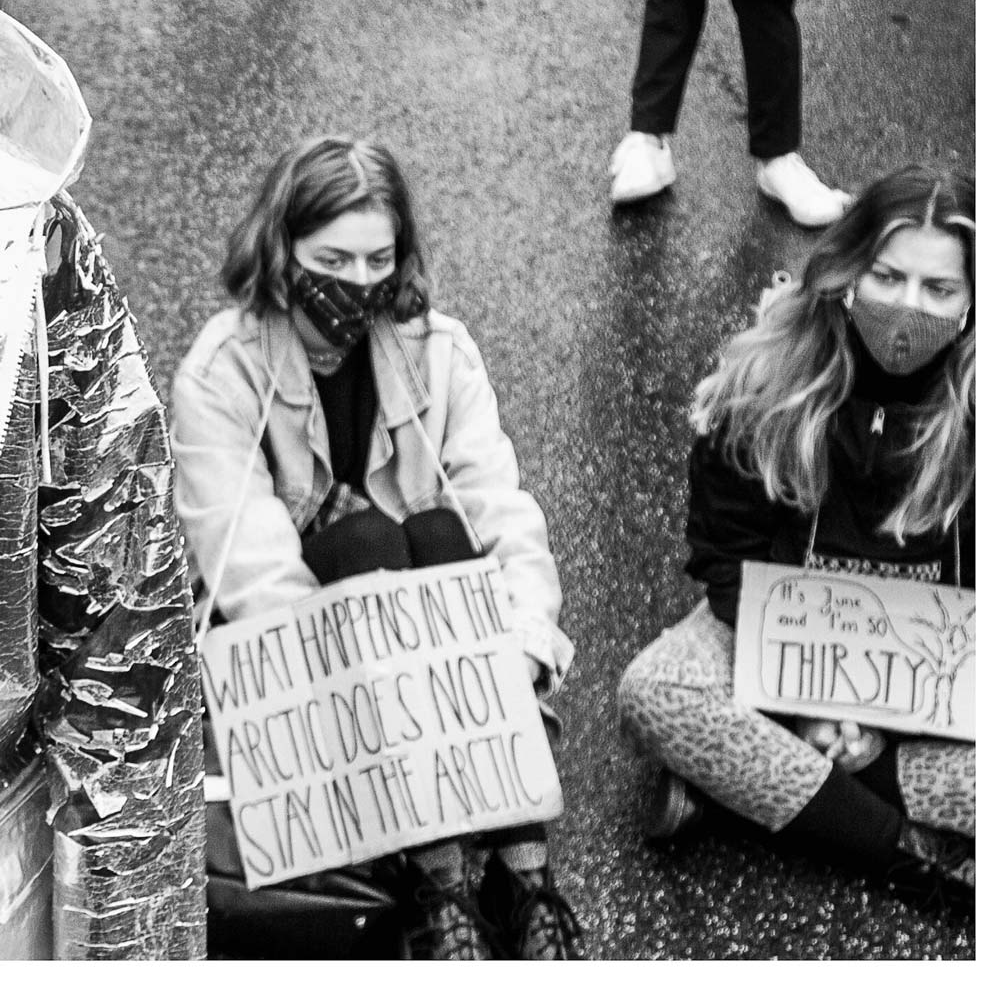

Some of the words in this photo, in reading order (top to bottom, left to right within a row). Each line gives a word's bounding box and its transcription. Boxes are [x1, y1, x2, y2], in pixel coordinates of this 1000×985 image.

[200, 624, 295, 714] WHAT
[295, 587, 421, 684] HAPPENS
[418, 580, 459, 648] IN
[450, 570, 513, 642] THE
[777, 614, 808, 628] and
[829, 611, 859, 633] I'm
[780, 580, 806, 604] It's
[820, 585, 862, 615] June
[226, 699, 335, 799] ARCTIC
[330, 672, 424, 765] DOES
[428, 651, 507, 735] NOT
[767, 637, 927, 714] THIRSTY
[238, 785, 324, 878] STAY
[322, 775, 364, 852] IN
[359, 755, 428, 835] THE
[435, 731, 544, 824] ARCTIC
